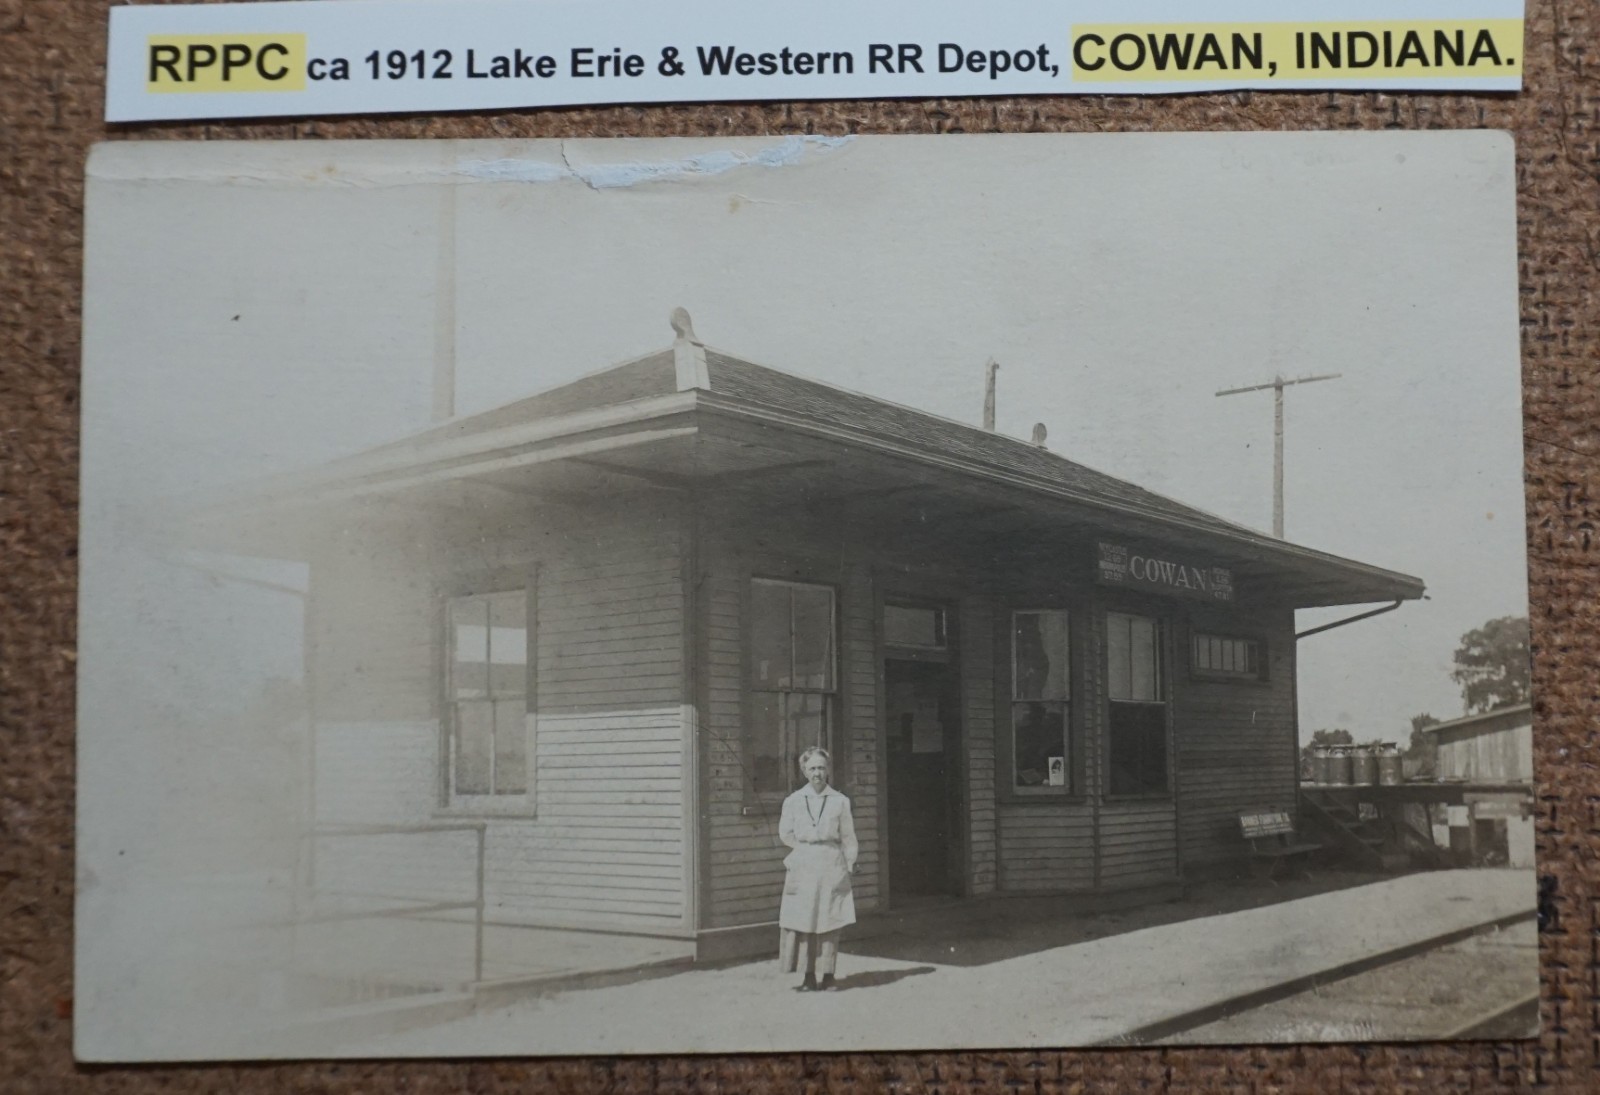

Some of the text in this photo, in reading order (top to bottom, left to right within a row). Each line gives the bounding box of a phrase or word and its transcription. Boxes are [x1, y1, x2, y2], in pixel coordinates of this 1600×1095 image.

[150, 29, 1515, 82] RPPC ca 1912 Lake Erie & Western RR Depot, COWAN, INDIANA.
[1130, 555, 1206, 591] COWAN
